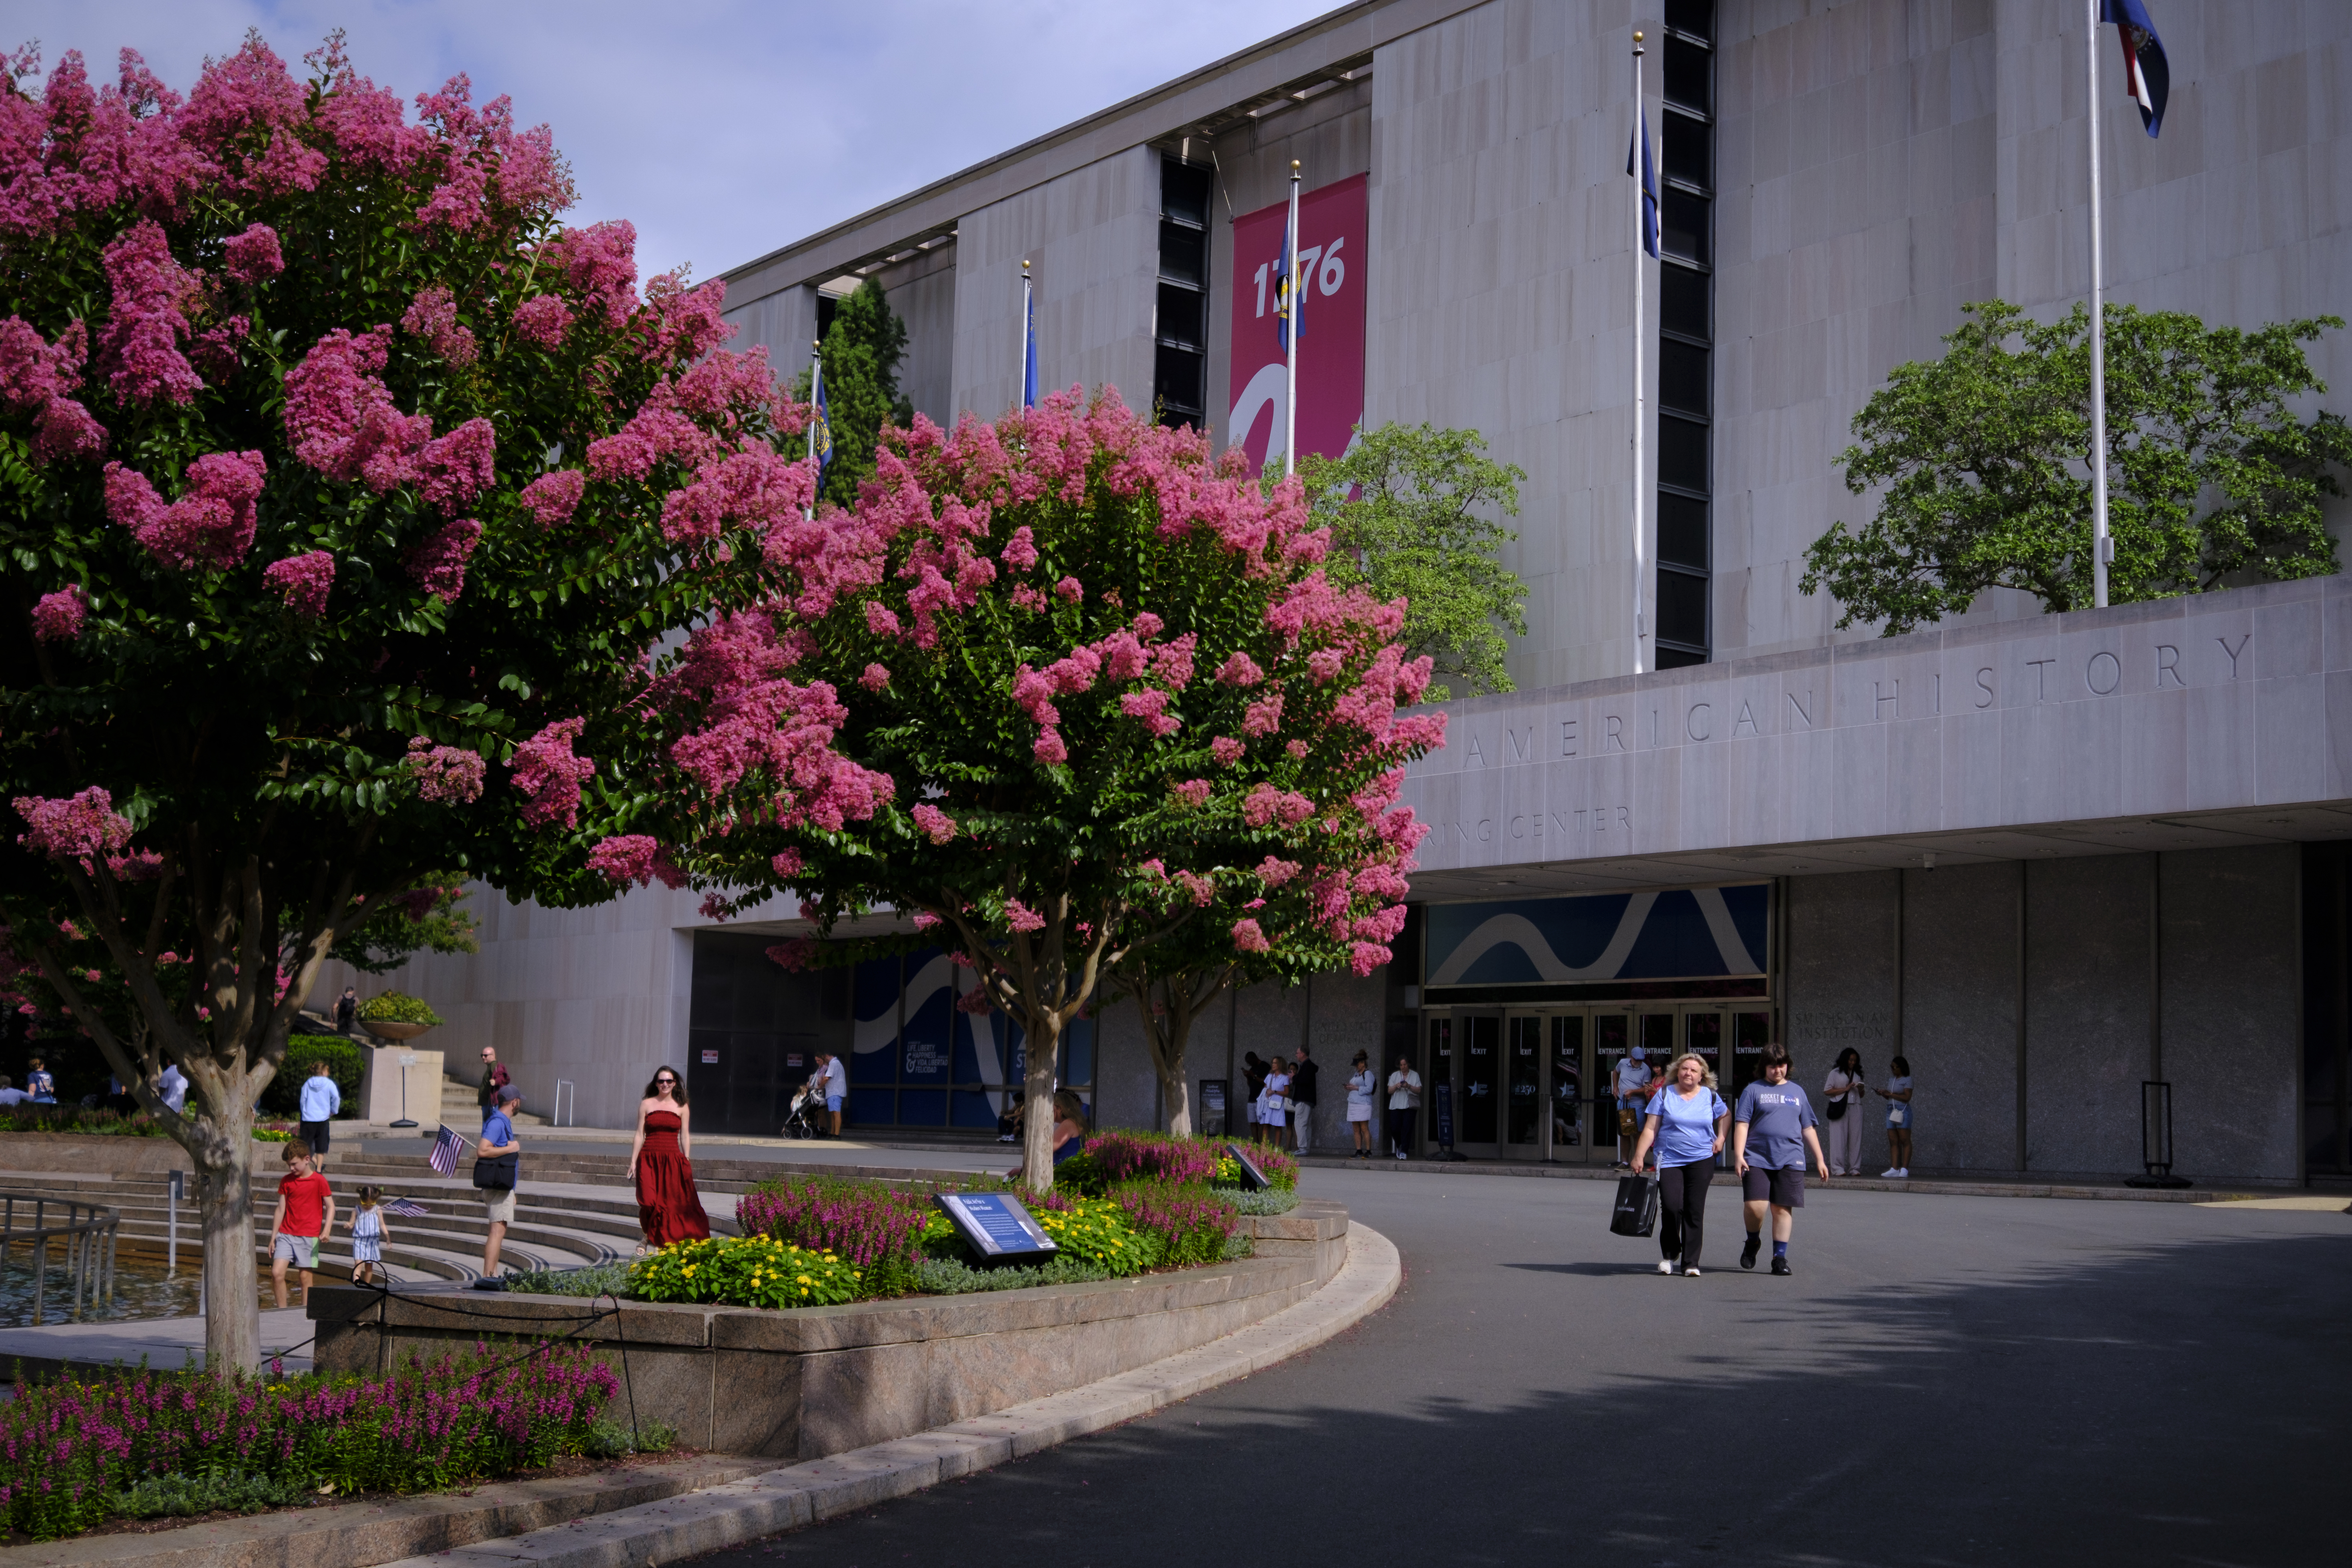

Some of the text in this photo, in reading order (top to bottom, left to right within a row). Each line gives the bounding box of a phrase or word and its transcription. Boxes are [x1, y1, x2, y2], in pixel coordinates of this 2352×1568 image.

[1463, 634, 2252, 769] AMERICAN HISTORY
[1422, 807, 1632, 847] RING CENTER
[1796, 1012, 1888, 1025] SMITHSONIAN
[1800, 1026, 1883, 1039] INSTITUTION
[1521, 1085, 1535, 1096] 250
